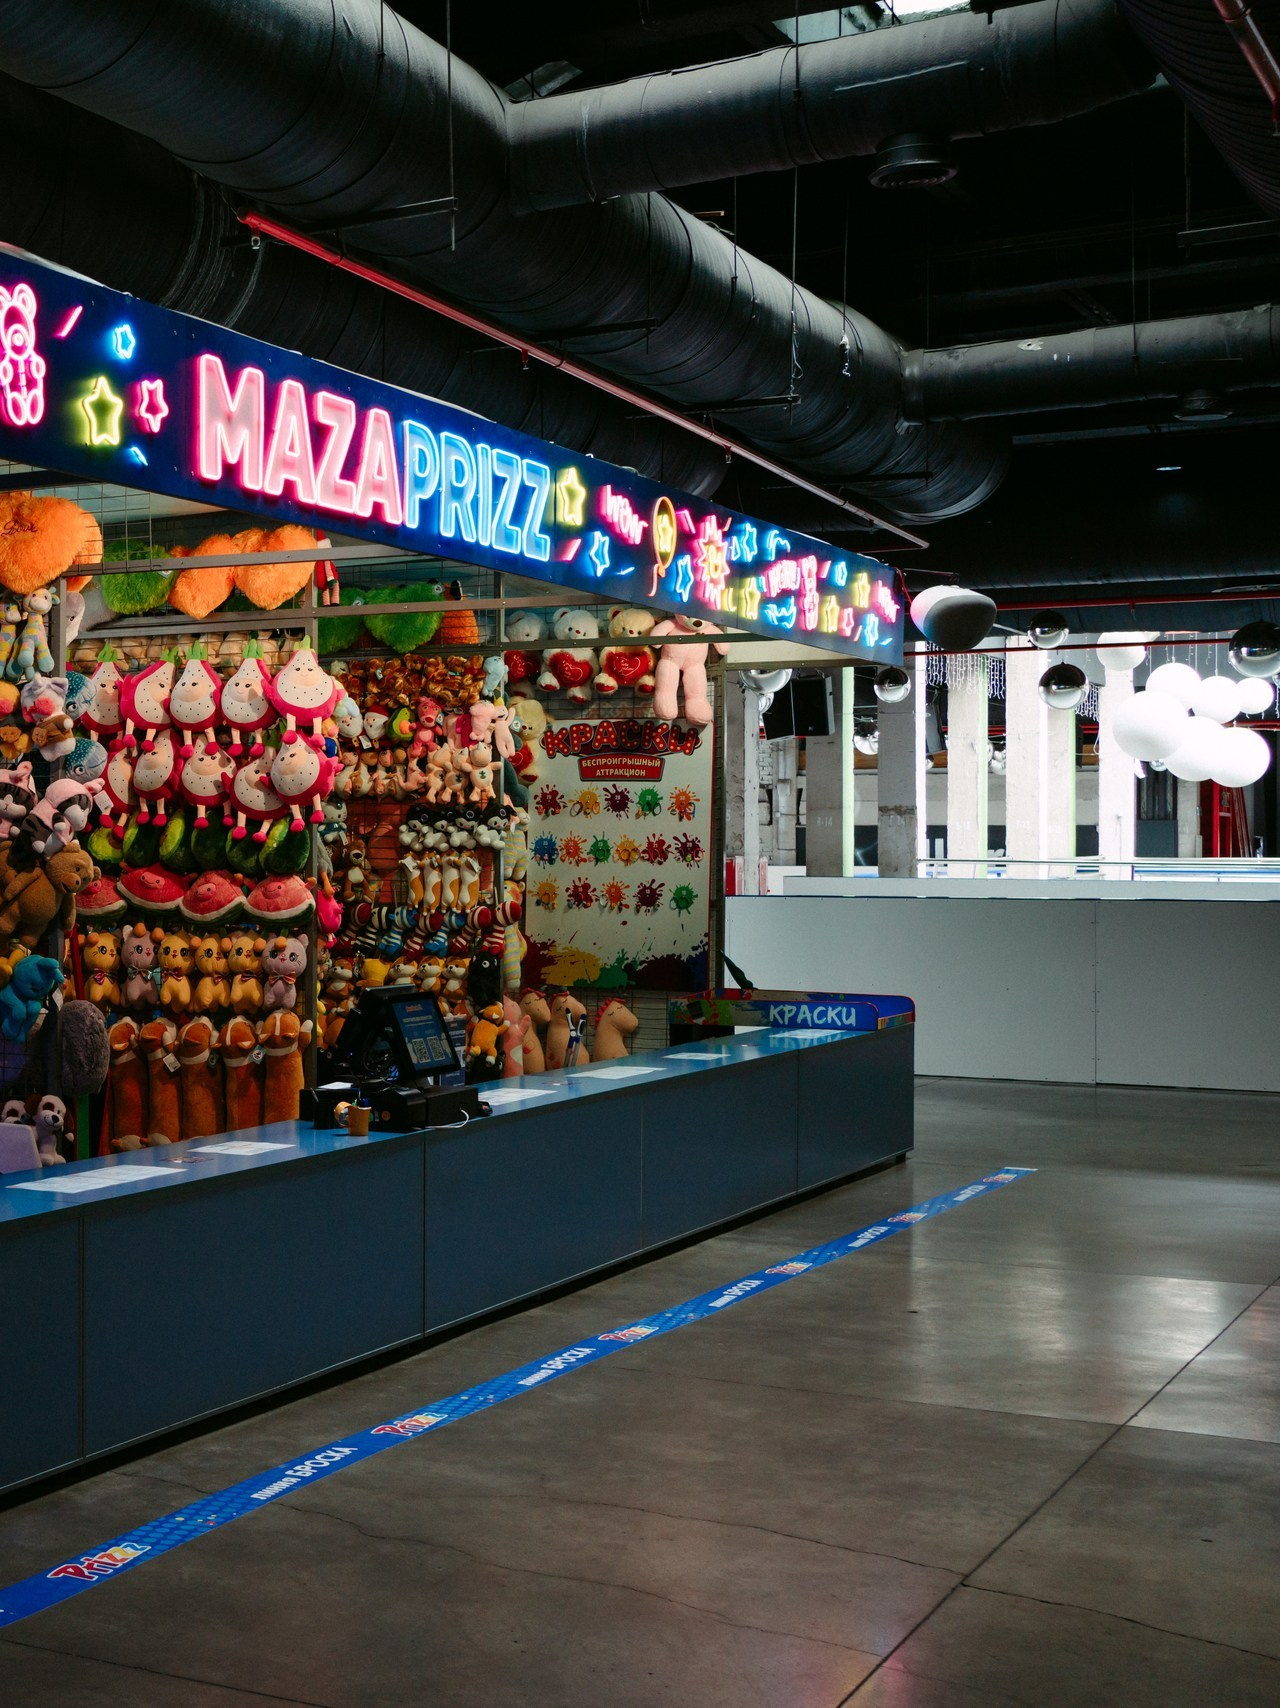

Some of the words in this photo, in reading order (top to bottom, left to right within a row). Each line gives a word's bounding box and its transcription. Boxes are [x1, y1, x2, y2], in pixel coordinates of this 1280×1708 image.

[544, 720, 698, 758] КРАСКИ
[581, 757, 661, 768] БЕСПРОИГРЫШНЫЙ
[595, 768, 646, 777] АТТРАКЦИОН
[769, 1004, 856, 1027] КРАСКИ
[284, 1445, 358, 1478] БРОСКА
[46, 1541, 151, 1582] Prizz
